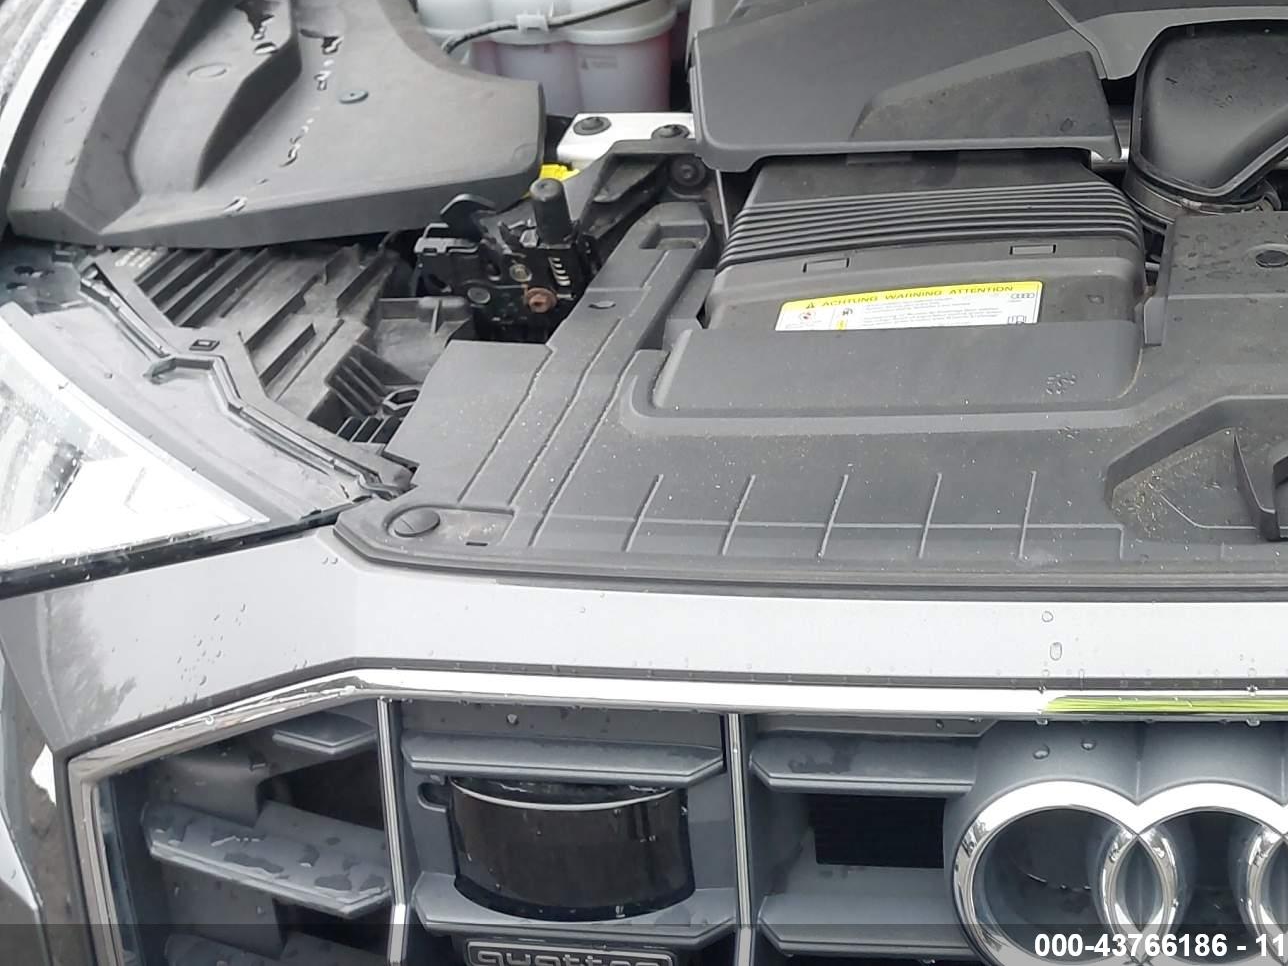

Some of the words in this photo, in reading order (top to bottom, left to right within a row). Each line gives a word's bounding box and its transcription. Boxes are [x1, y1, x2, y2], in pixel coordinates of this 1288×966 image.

[822, 295, 879, 307] ACHTUNG
[885, 290, 943, 301] WARNING
[950, 286, 1014, 295] ATTENTION
